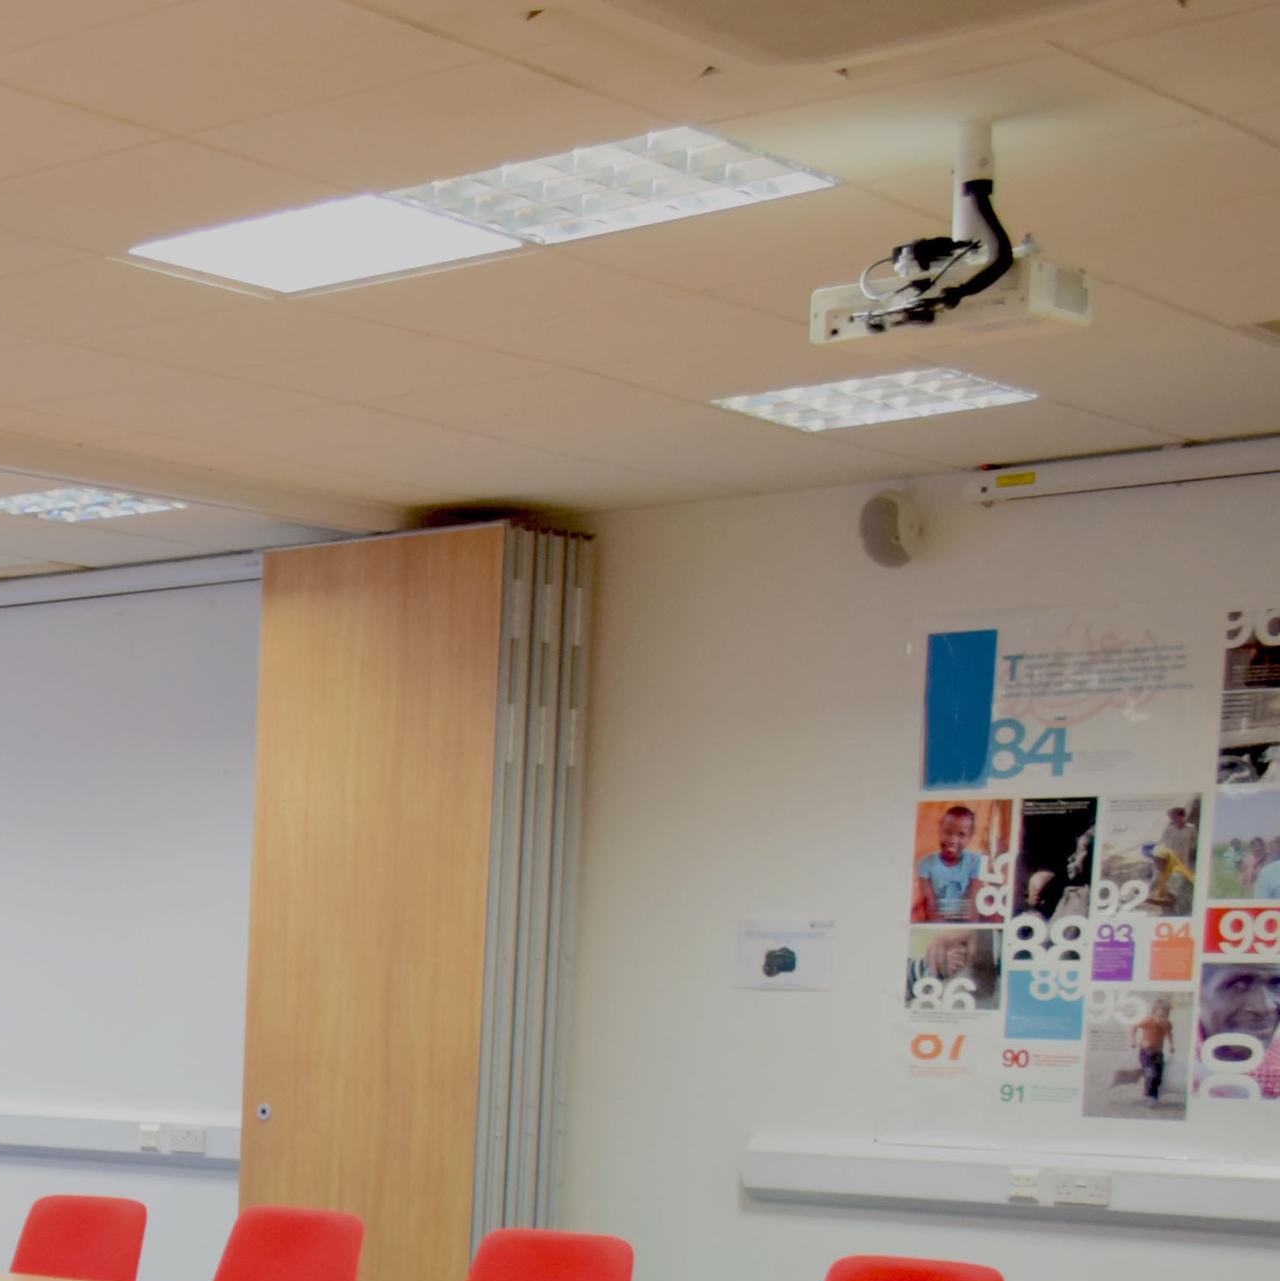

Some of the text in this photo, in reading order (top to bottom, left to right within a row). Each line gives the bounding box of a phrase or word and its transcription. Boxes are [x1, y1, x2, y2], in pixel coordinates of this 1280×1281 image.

[986, 718, 1072, 779] 84
[1095, 879, 1149, 918] 92
[1097, 924, 1133, 944] 93
[1218, 910, 1280, 955] 99
[911, 976, 977, 1010] 86
[1002, 1049, 1029, 1068] 90
[1000, 1084, 1025, 1102] 91
